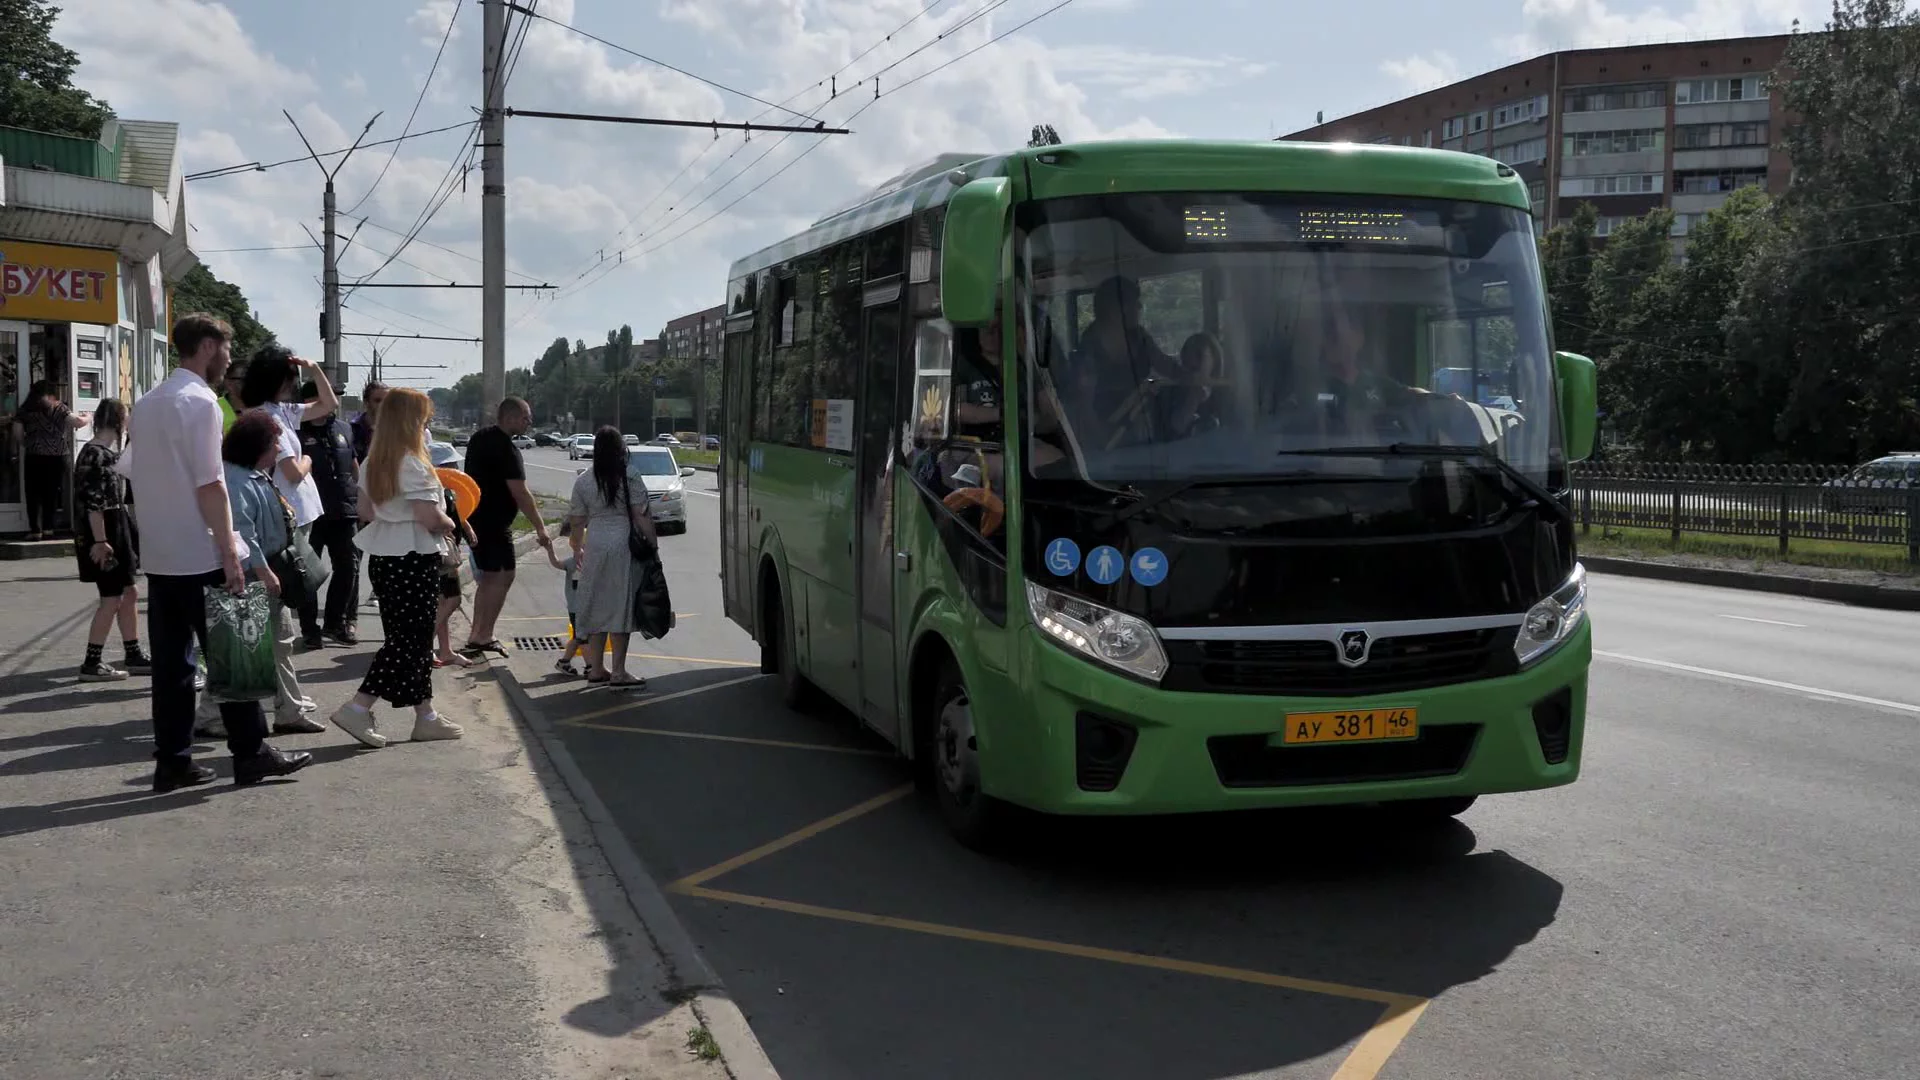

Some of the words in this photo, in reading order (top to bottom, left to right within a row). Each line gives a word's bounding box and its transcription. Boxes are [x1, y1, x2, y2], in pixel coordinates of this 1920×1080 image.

[2, 262, 107, 303] БУКЕТ
[1296, 721, 1322, 739] АУ
[1333, 714, 1374, 737] 381
[1388, 710, 1409, 728] 46
